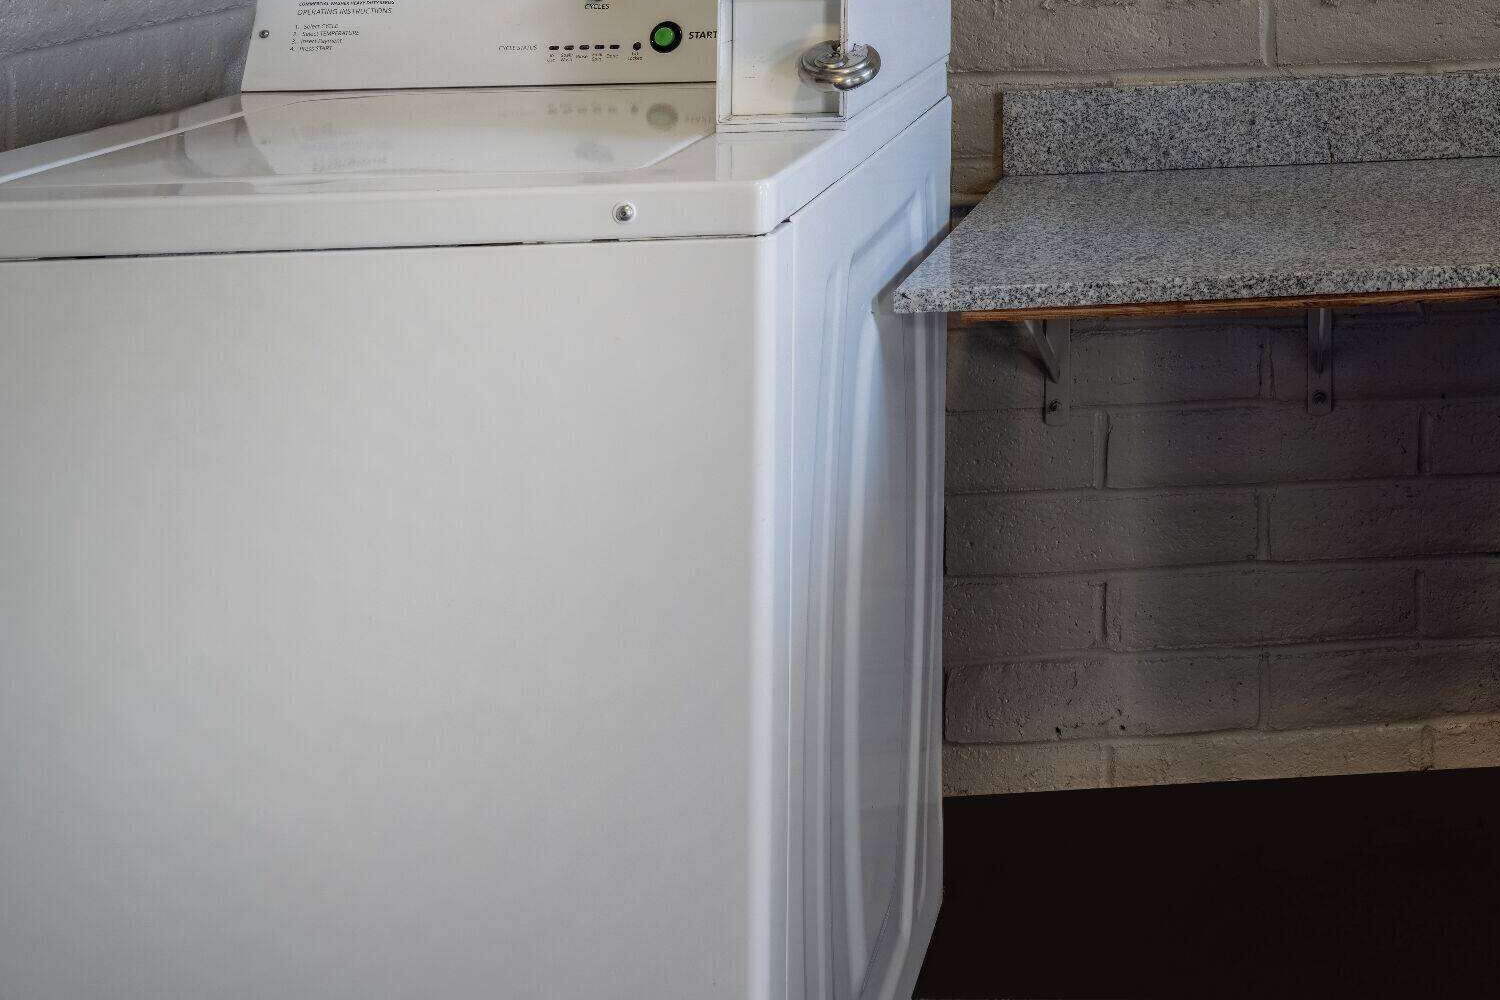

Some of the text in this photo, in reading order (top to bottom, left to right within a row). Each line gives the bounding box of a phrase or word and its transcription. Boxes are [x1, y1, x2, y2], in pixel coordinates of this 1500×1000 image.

[297, 7, 392, 16] OPERATING INSTRUCTIONS
[688, 30, 717, 39] START
